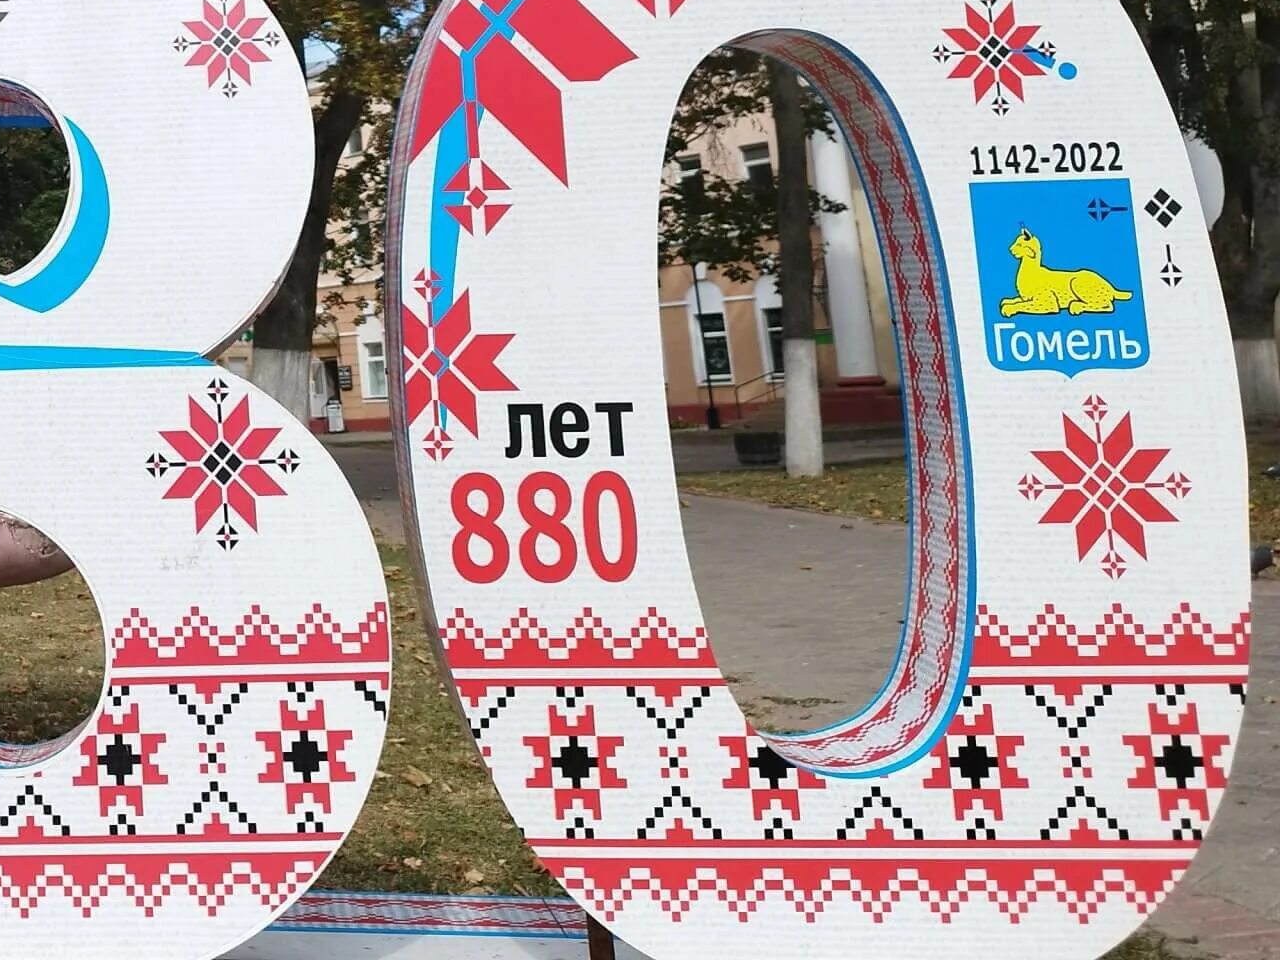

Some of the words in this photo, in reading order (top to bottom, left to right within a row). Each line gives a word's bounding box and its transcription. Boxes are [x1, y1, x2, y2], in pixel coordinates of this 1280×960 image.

[969, 142, 1123, 176] 1142-2022
[993, 322, 1143, 363] Гомель
[504, 401, 633, 459] лет
[450, 471, 639, 584] 880
